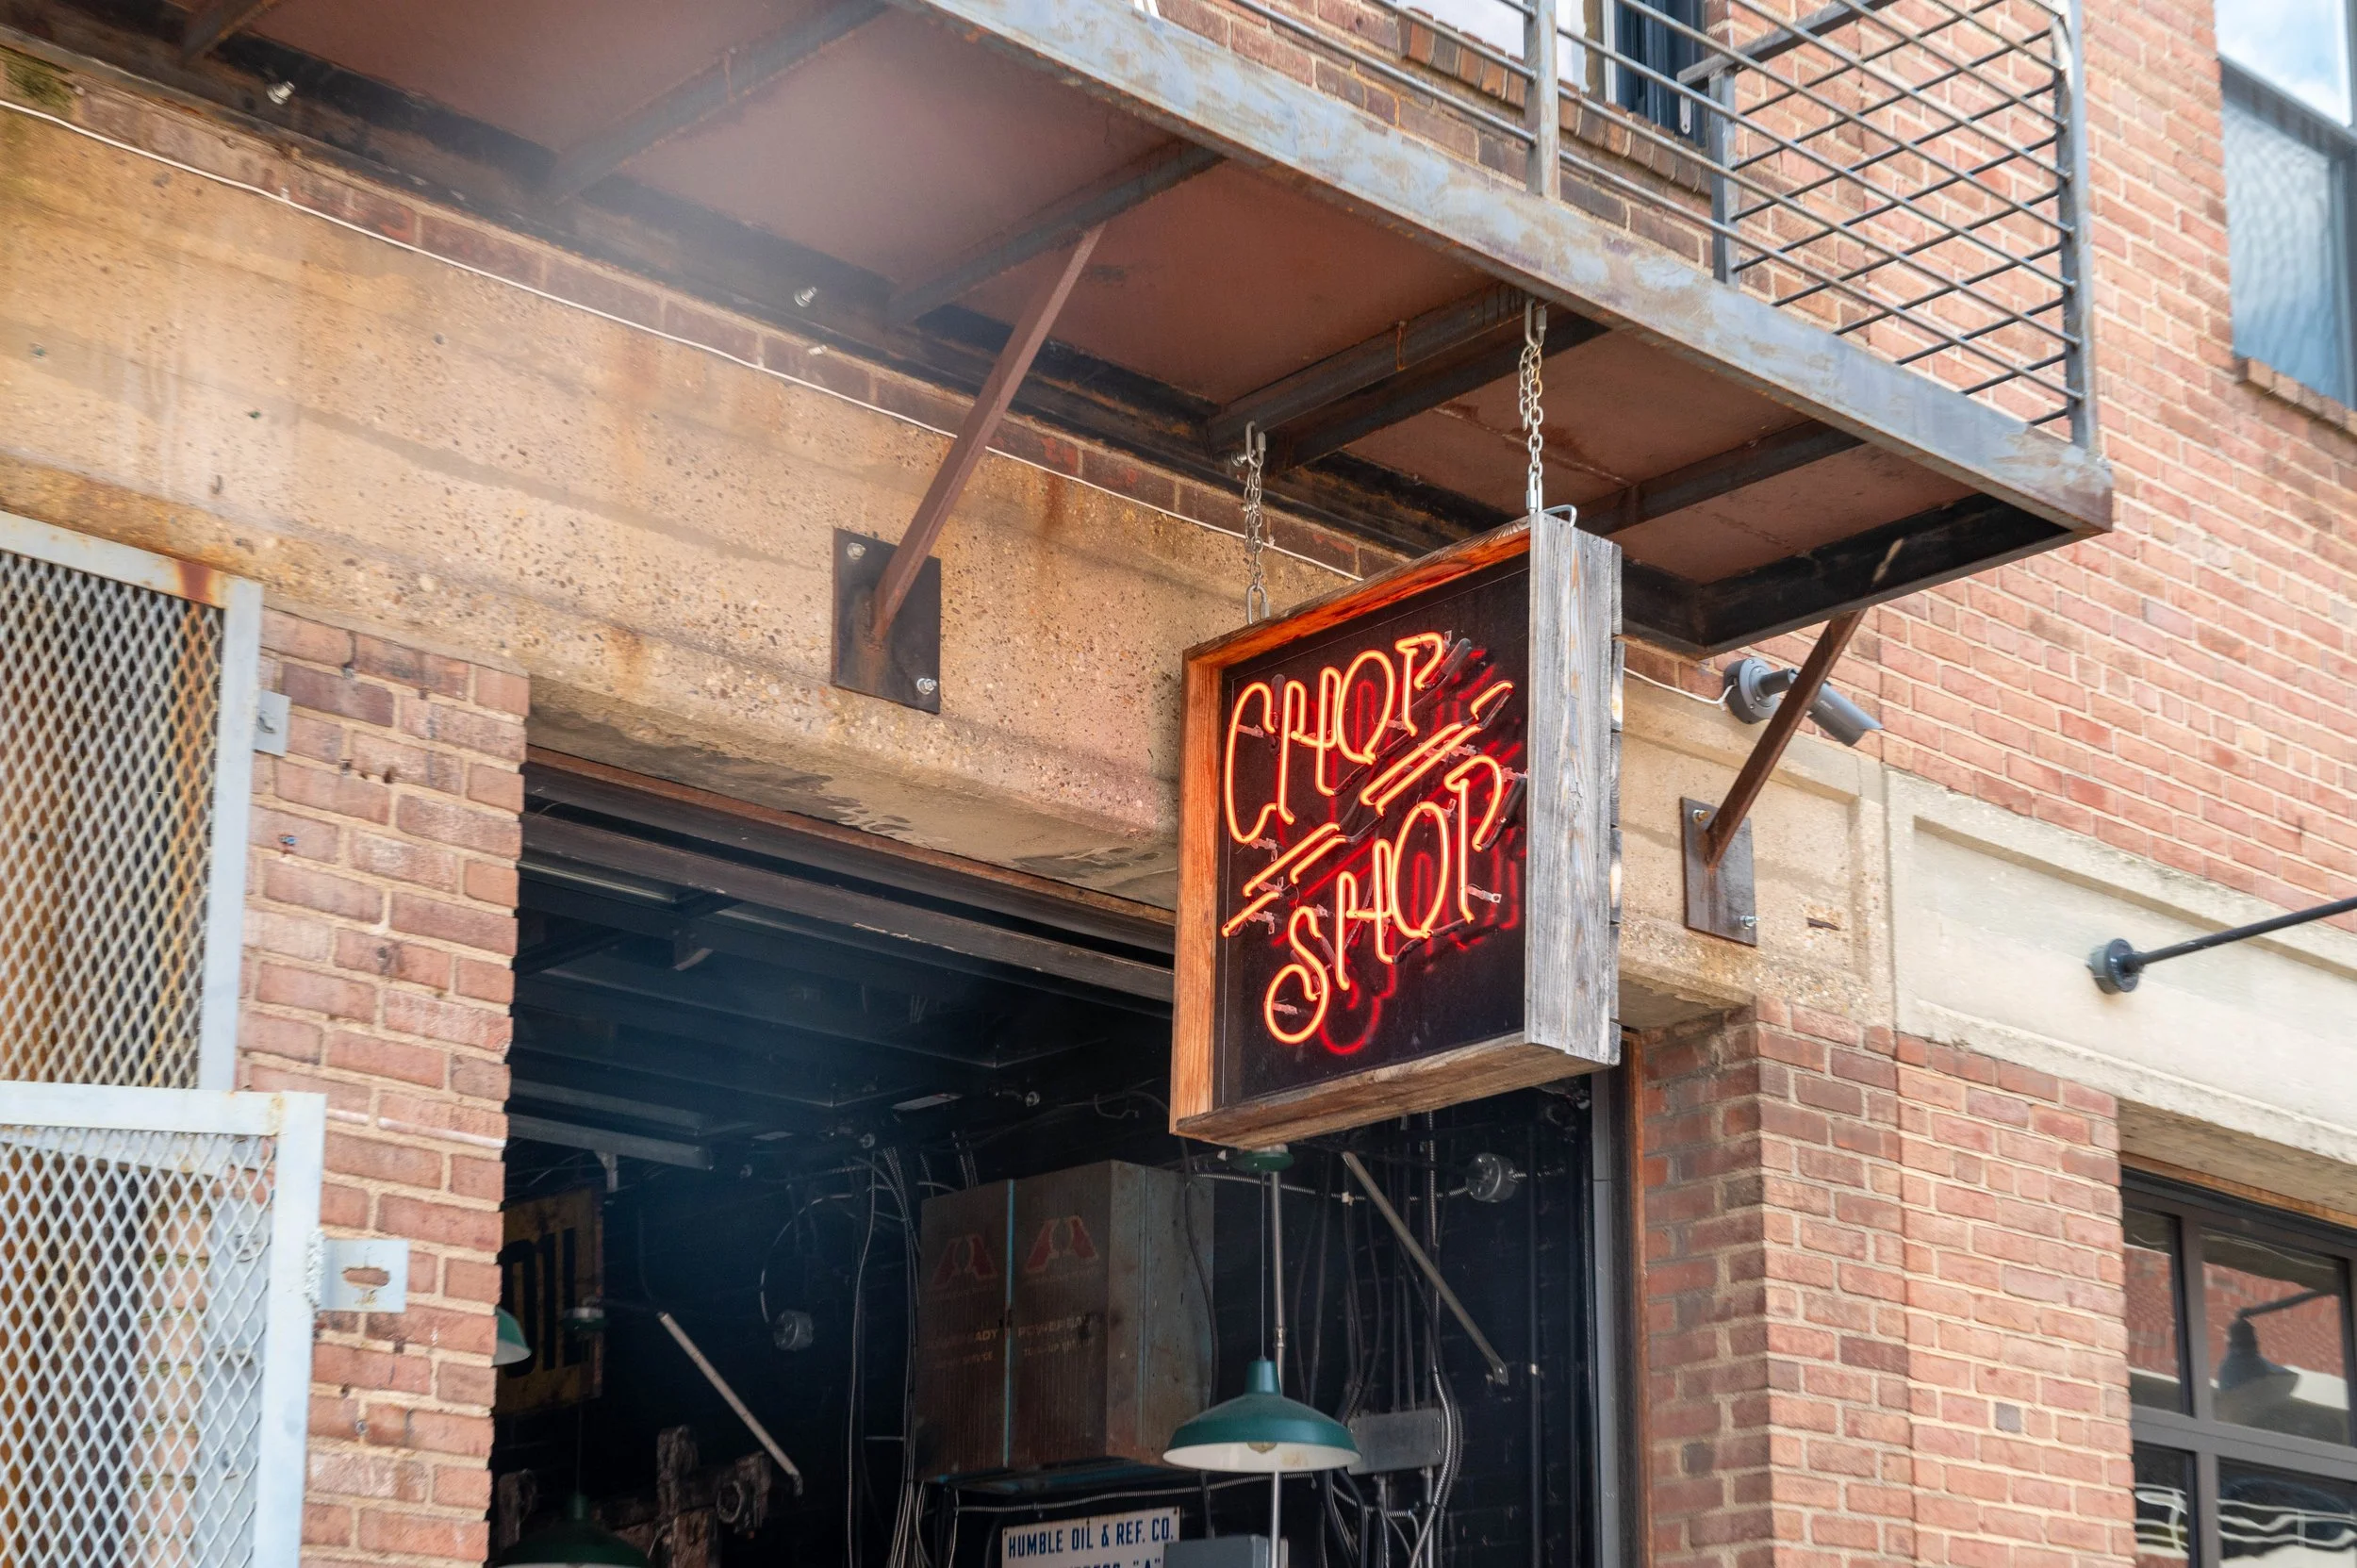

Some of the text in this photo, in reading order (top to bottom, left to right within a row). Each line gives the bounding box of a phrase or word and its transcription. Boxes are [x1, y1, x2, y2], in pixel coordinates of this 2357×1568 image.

[1226, 632, 1445, 843] CHOP
[1264, 754, 1505, 1045] SHOP
[1008, 1516, 1174, 1559] HUMBLE OIL & REF. CO.
